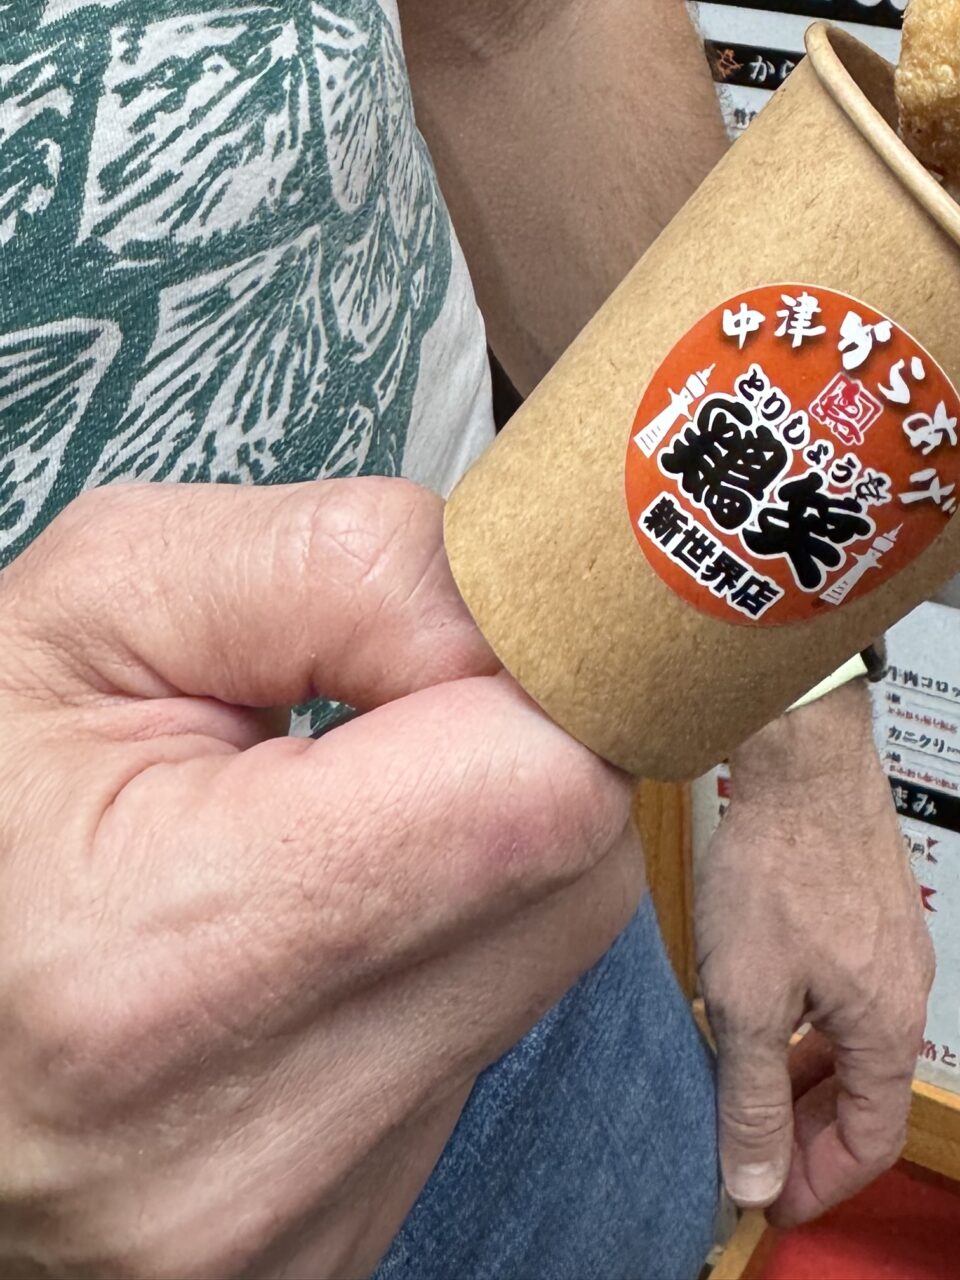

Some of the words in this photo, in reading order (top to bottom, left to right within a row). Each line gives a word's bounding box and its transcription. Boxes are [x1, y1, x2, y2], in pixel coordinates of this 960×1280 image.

[721, 290, 959, 515] 中津からあげ
[643, 495, 782, 616] 新世界店
